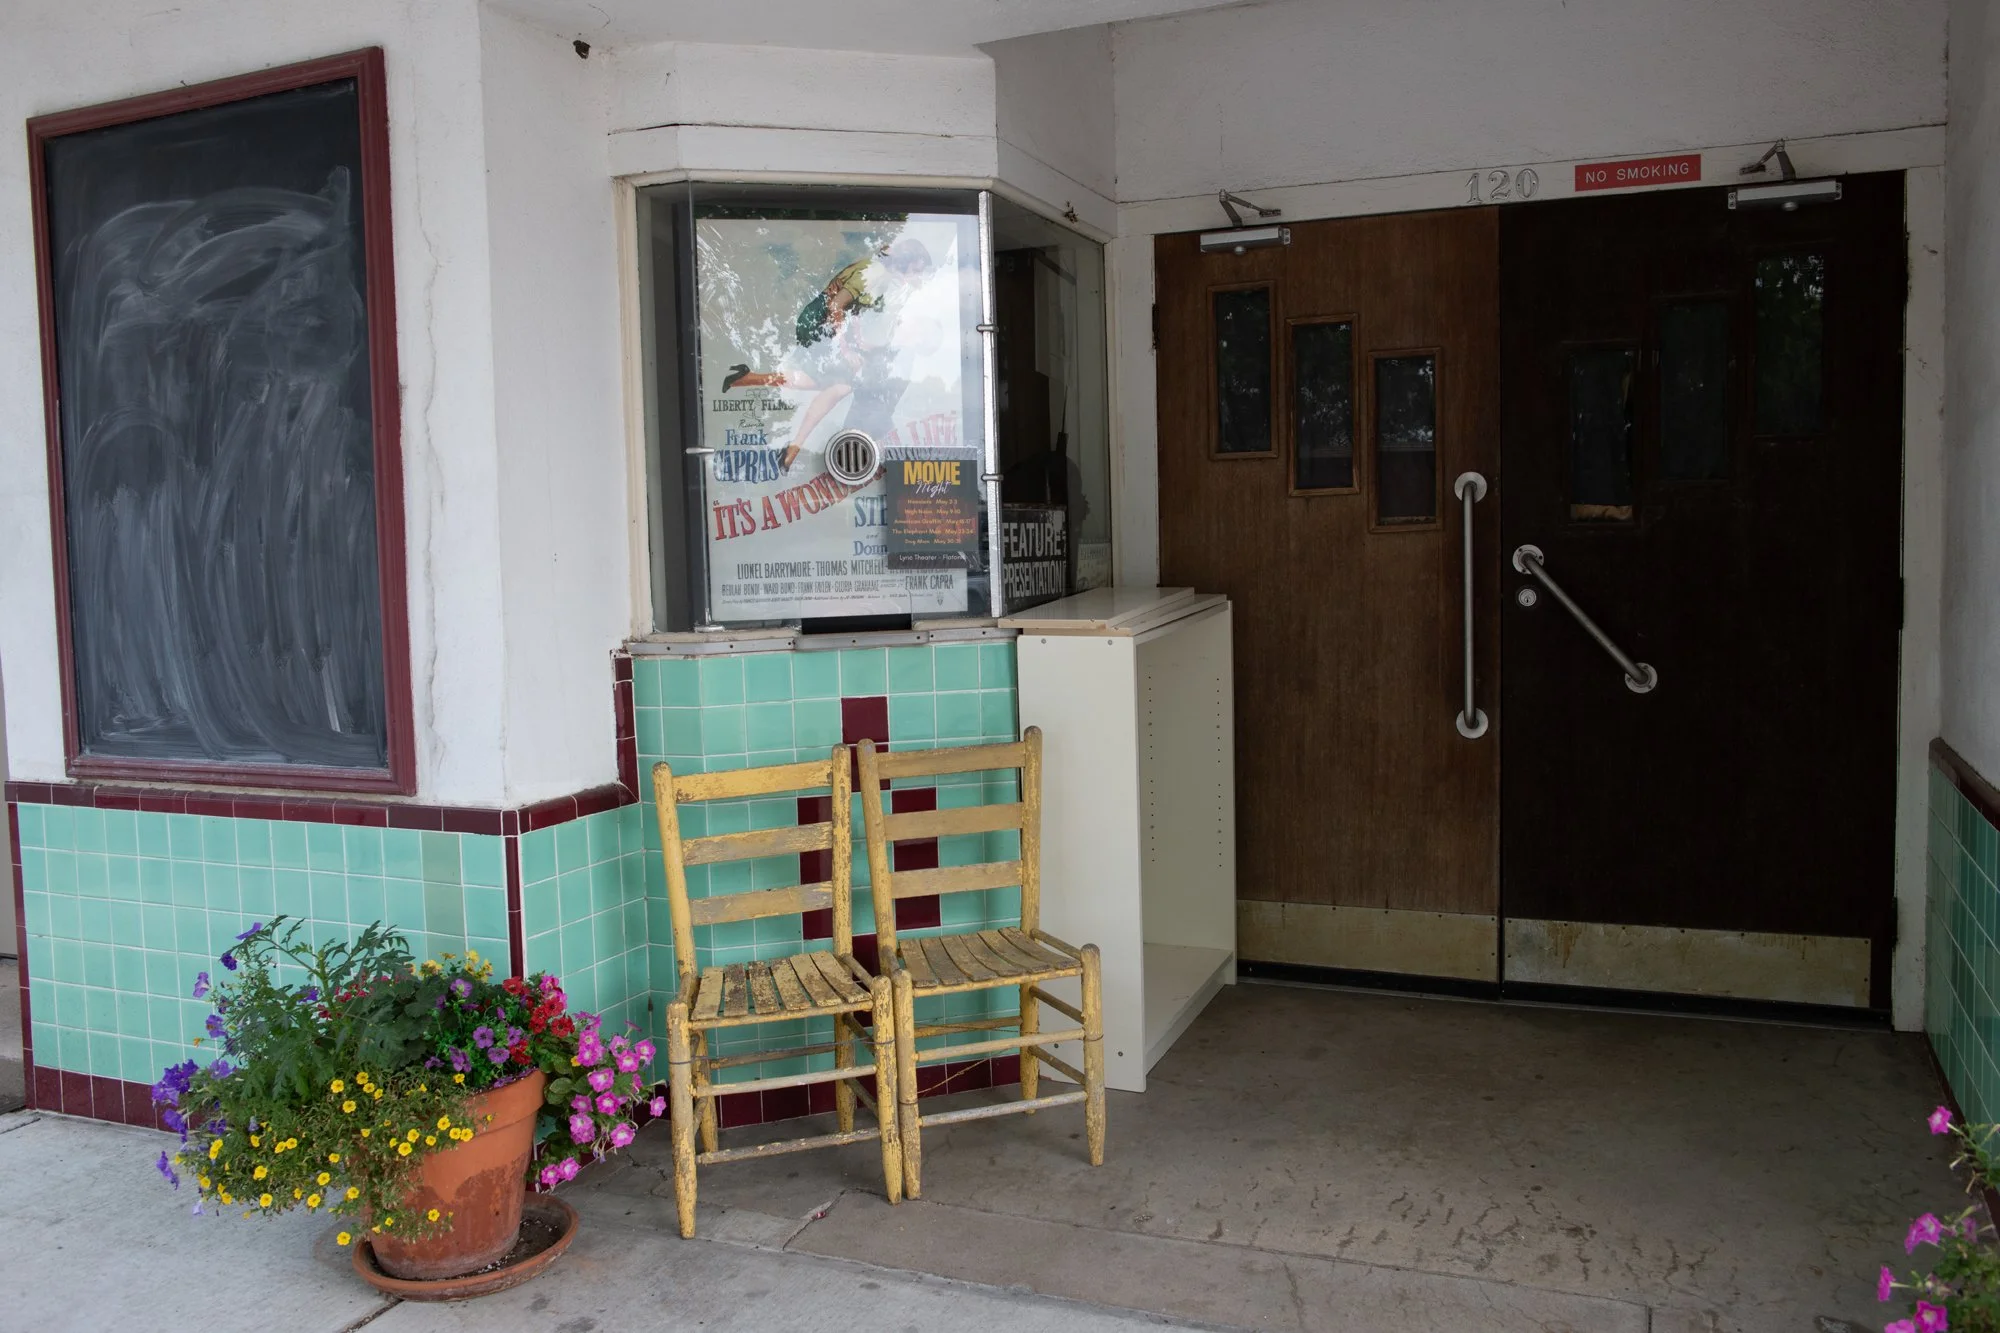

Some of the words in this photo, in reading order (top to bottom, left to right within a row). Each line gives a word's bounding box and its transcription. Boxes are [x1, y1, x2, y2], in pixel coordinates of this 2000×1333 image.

[1585, 170, 1607, 184] NO
[1616, 162, 1690, 181] SMOKING
[1465, 168, 1540, 205] 120
[713, 399, 754, 412] LIBERTY
[725, 429, 768, 446] Frank
[904, 461, 960, 485] MOVIE
[915, 479, 952, 498] Night
[761, 495, 781, 531] A
[1002, 521, 1062, 558] FEATURE
[899, 554, 914, 562] Lyric
[737, 563, 763, 580] LIONEL
[764, 561, 812, 579] BARRYMORE
[816, 560, 847, 577] THOMAS
[851, 559, 885, 575] MITCHELL
[1003, 559, 1062, 599] PRESENTATION
[905, 575, 928, 590] FRANK
[930, 574, 954, 590] CAPRA
